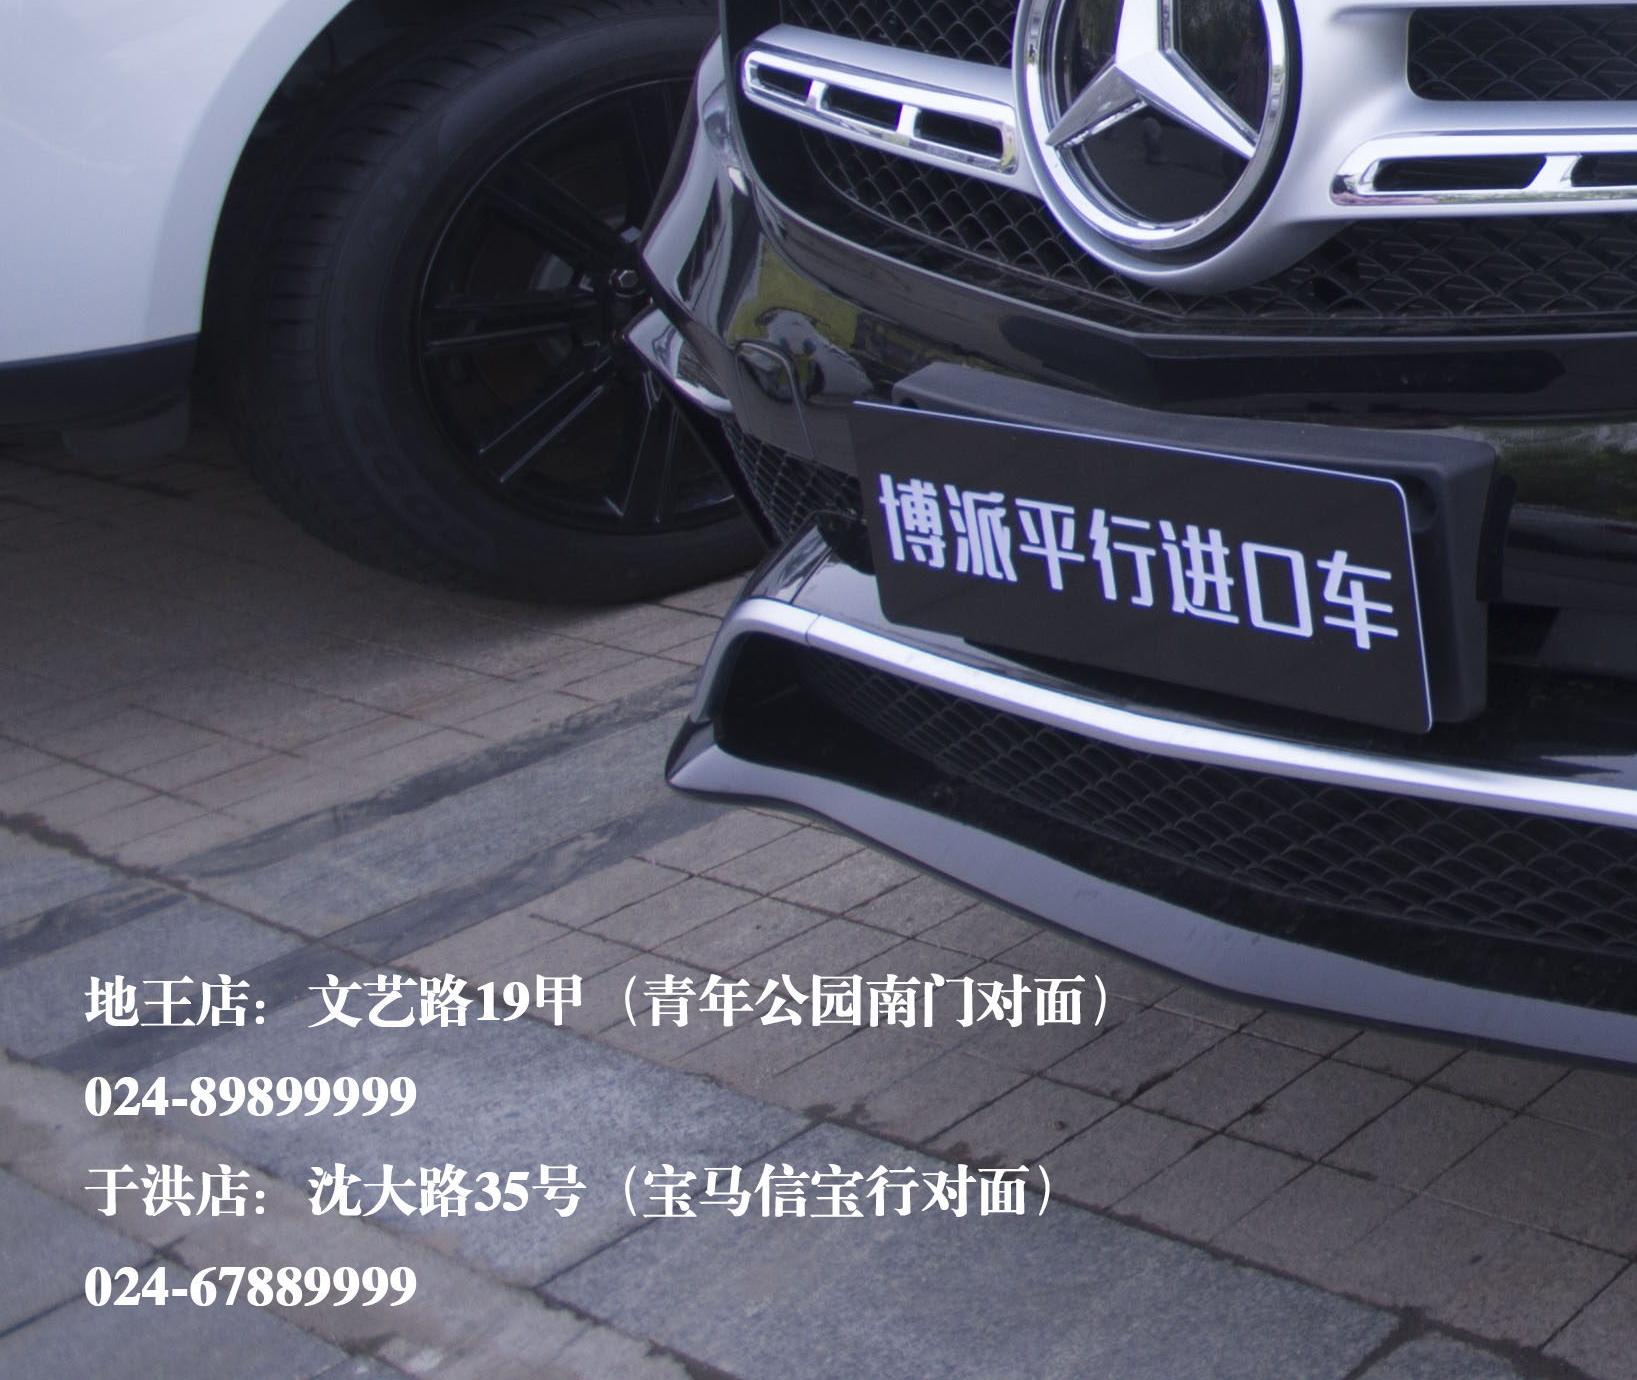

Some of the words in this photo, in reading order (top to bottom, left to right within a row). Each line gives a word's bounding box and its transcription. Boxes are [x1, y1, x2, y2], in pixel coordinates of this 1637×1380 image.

[878, 472, 1400, 651] 博派平行进口车
